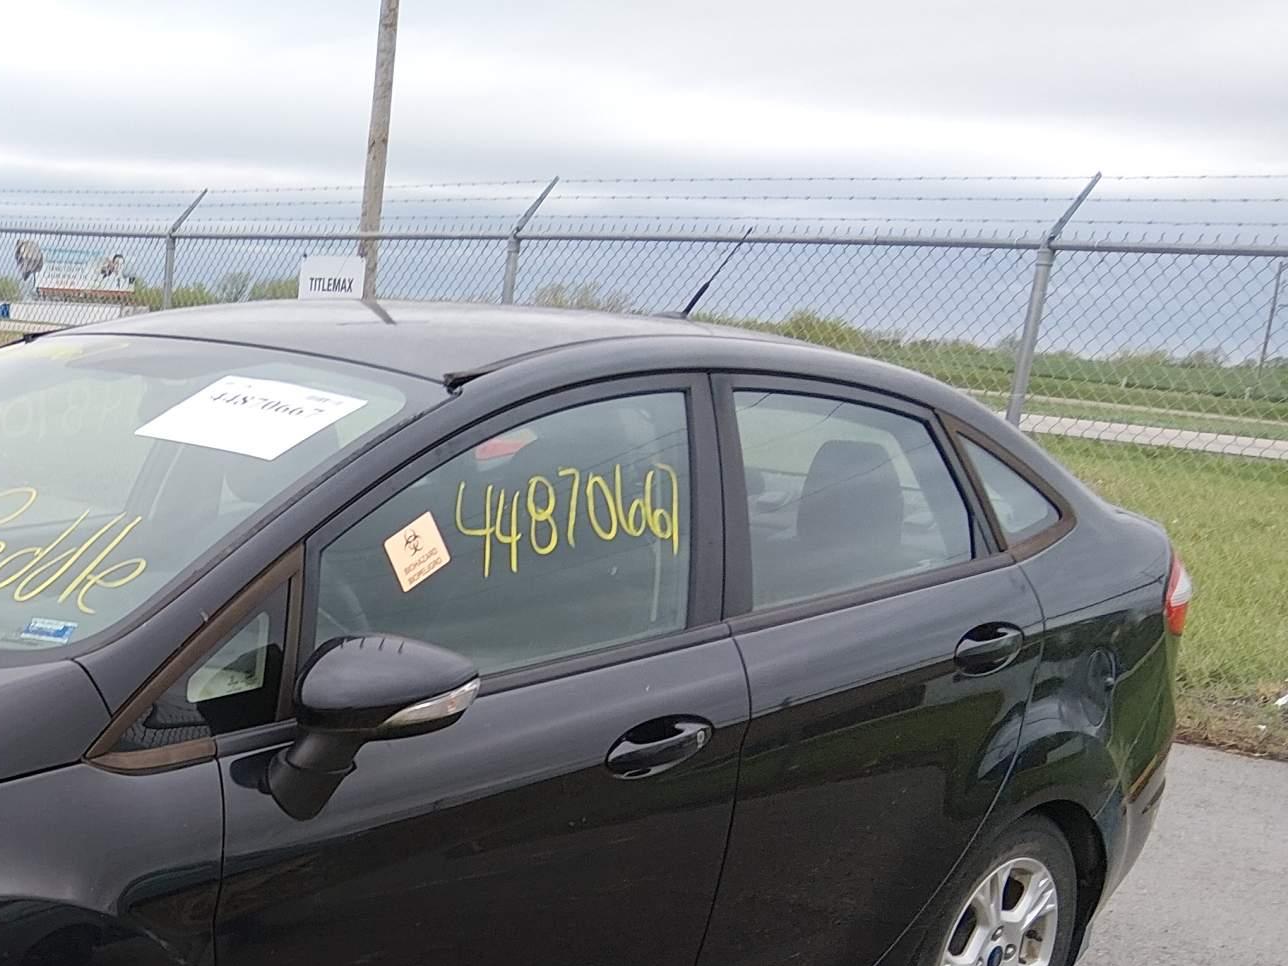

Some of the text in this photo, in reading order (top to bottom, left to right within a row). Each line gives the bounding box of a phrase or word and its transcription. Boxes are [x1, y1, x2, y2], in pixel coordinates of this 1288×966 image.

[309, 277, 354, 292] TITLEMAX
[456, 463, 679, 578] 44870667
[404, 547, 438, 575] BIOHAZARD
